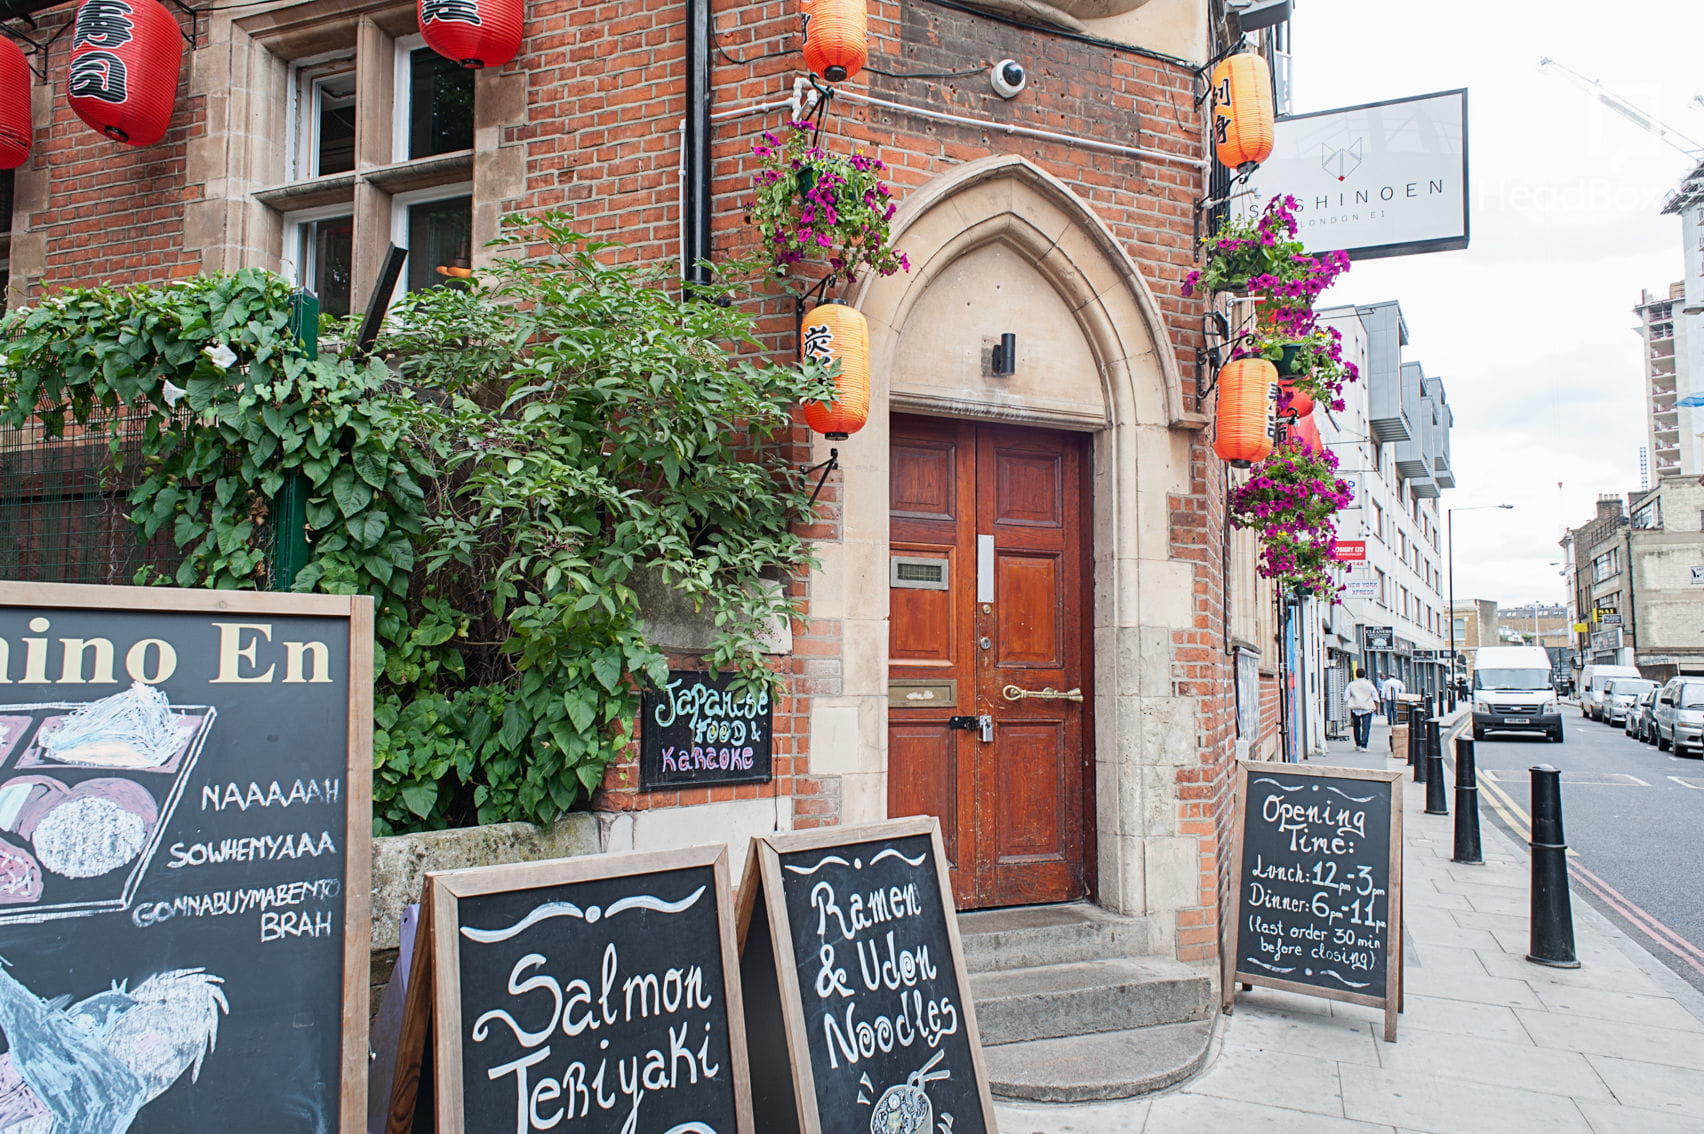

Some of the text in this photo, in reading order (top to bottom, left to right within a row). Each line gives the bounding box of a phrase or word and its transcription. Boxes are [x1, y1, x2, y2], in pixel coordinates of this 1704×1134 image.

[1250, 179, 1443, 219] SSHINOEN
[1300, 213, 1360, 228] LONDON
[0, 617, 333, 684] ino En
[751, 720, 761, 742] &
[1263, 794, 1365, 838] Opening
[1283, 823, 1354, 854] Time:
[1252, 854, 1310, 882] Lunch:
[810, 881, 921, 940] Ramen
[1248, 882, 1310, 912] Dinner:
[261, 910, 332, 943] BRAH
[1290, 923, 1328, 940] order
[1333, 928, 1355, 945] 30
[1358, 934, 1380, 949] min
[816, 929, 937, 998] & Udon
[1260, 936, 1302, 961] before
[472, 942, 712, 1048] Salmon
[824, 989, 957, 1069] Noodles
